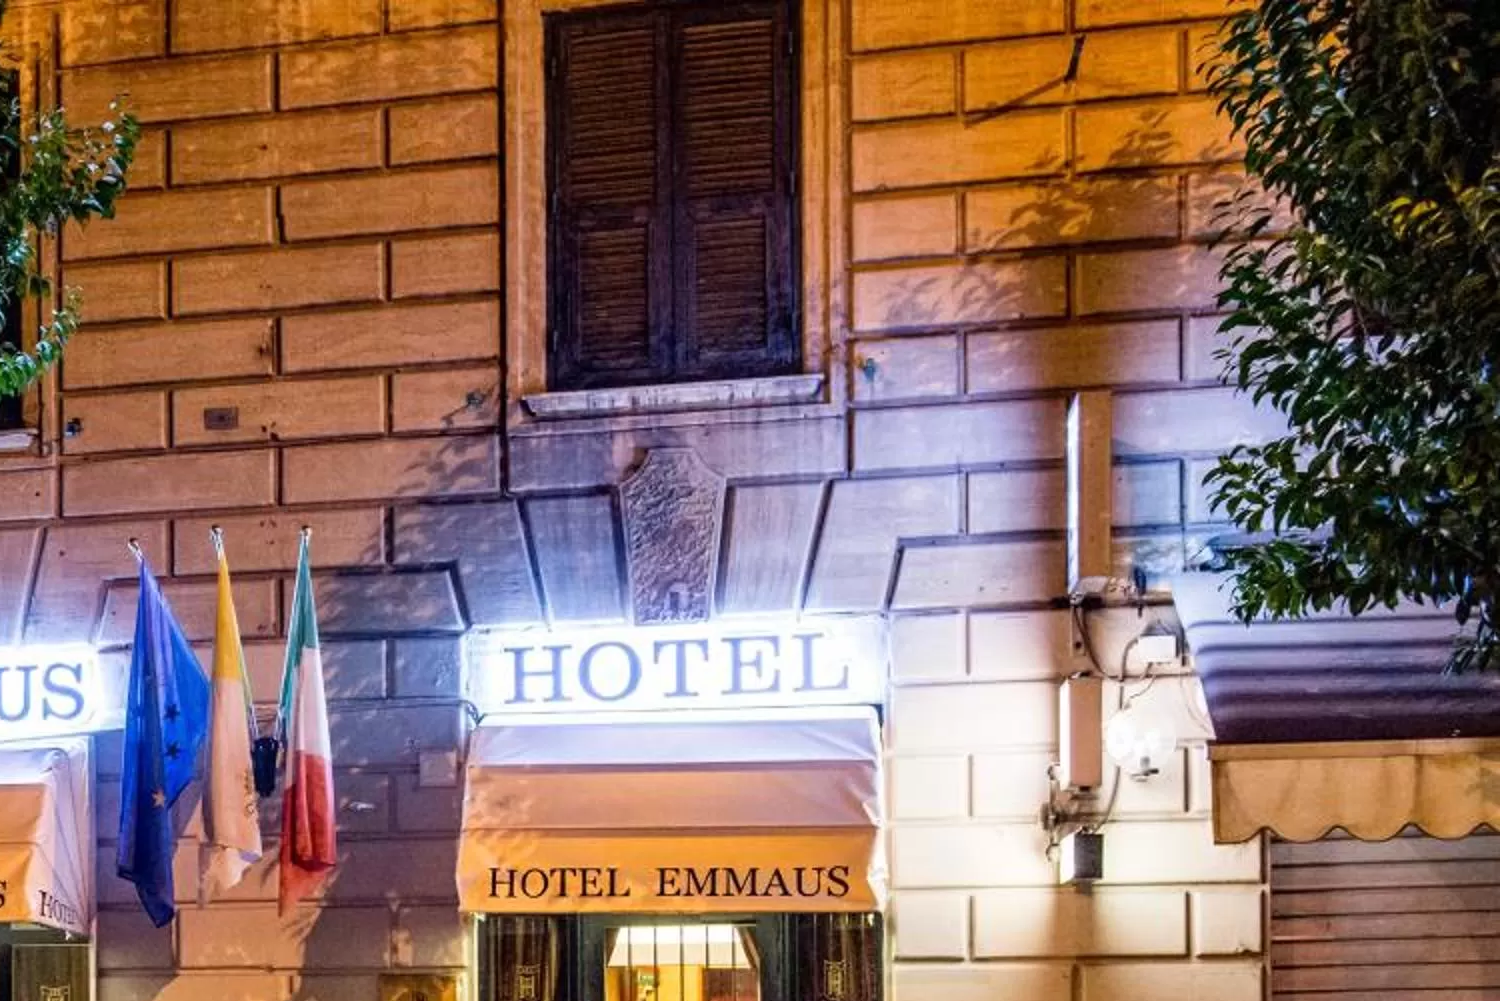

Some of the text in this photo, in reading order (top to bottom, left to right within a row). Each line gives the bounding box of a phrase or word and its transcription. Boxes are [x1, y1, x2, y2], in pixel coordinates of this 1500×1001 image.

[503, 632, 849, 704] HOTEL
[488, 865, 850, 898] HOTEL EMMAUS
